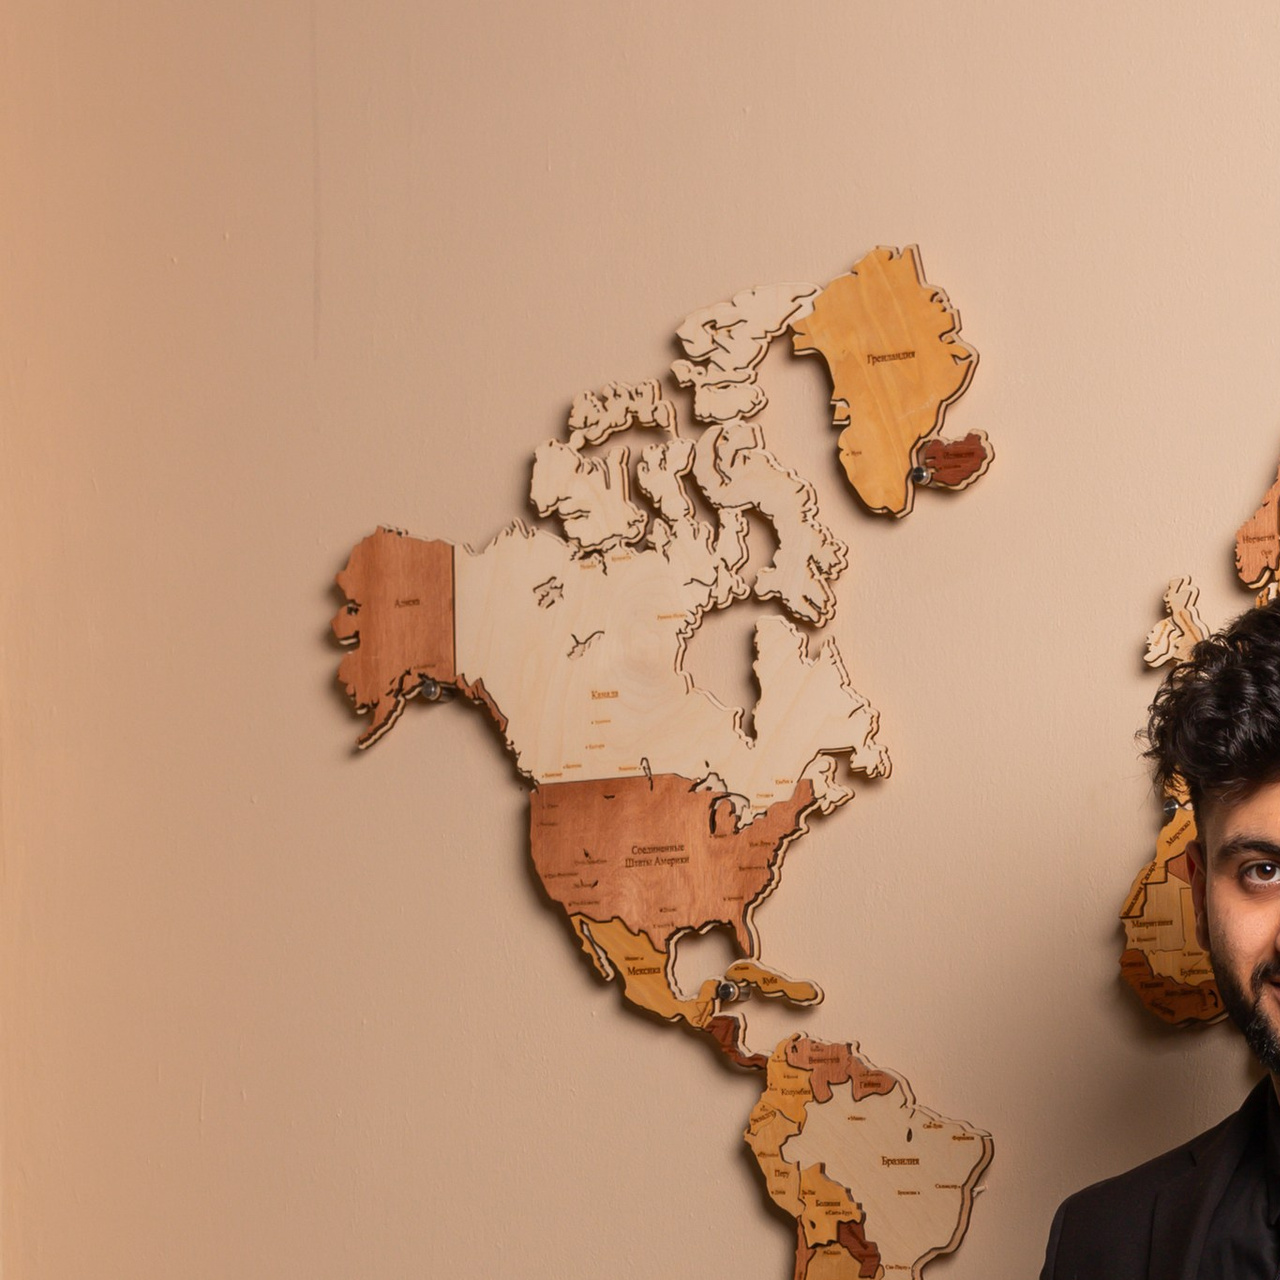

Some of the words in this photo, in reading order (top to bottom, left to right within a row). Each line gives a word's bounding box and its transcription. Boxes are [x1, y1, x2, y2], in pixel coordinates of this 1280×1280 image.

[867, 351, 916, 365] Гренландия
[1242, 534, 1276, 545] Норвегия
[1165, 820, 1191, 847] Марокко
[625, 857, 654, 869] Штаты
[654, 855, 691, 869] Америки
[881, 1156, 920, 1168] Бразилия
[774, 1169, 790, 1179] Перу
